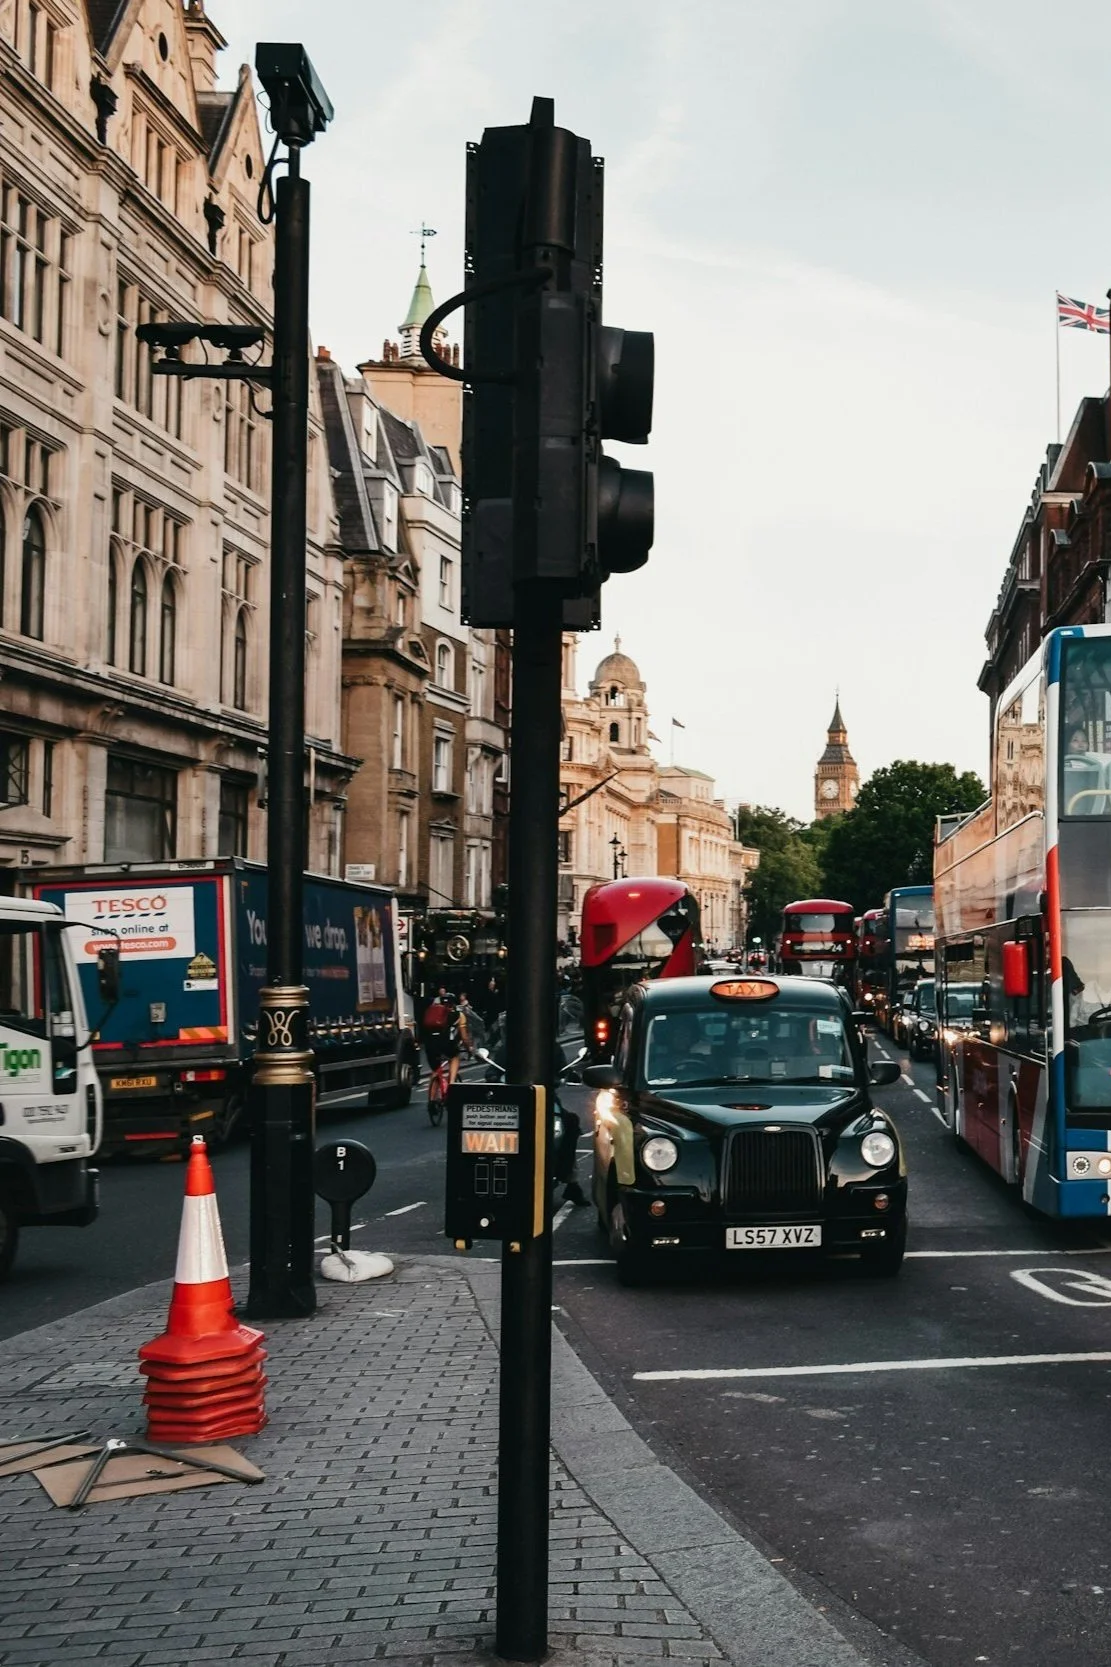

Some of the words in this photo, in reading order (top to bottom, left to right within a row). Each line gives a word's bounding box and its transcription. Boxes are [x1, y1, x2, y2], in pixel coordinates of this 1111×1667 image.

[92, 895, 167, 913] TESCO
[121, 924, 155, 935] online
[158, 923, 169, 932] at
[305, 923, 322, 949] we
[92, 940, 169, 951] wwwtesco.com
[725, 984, 764, 995] TAXI
[466, 1105, 518, 1113] PEDESTRIANS
[465, 1132, 518, 1152] WAIT
[337, 1147, 346, 1157] B
[338, 1160, 344, 1170] 1
[733, 1229, 777, 1245] LS57
[782, 1228, 814, 1244] XVZ
